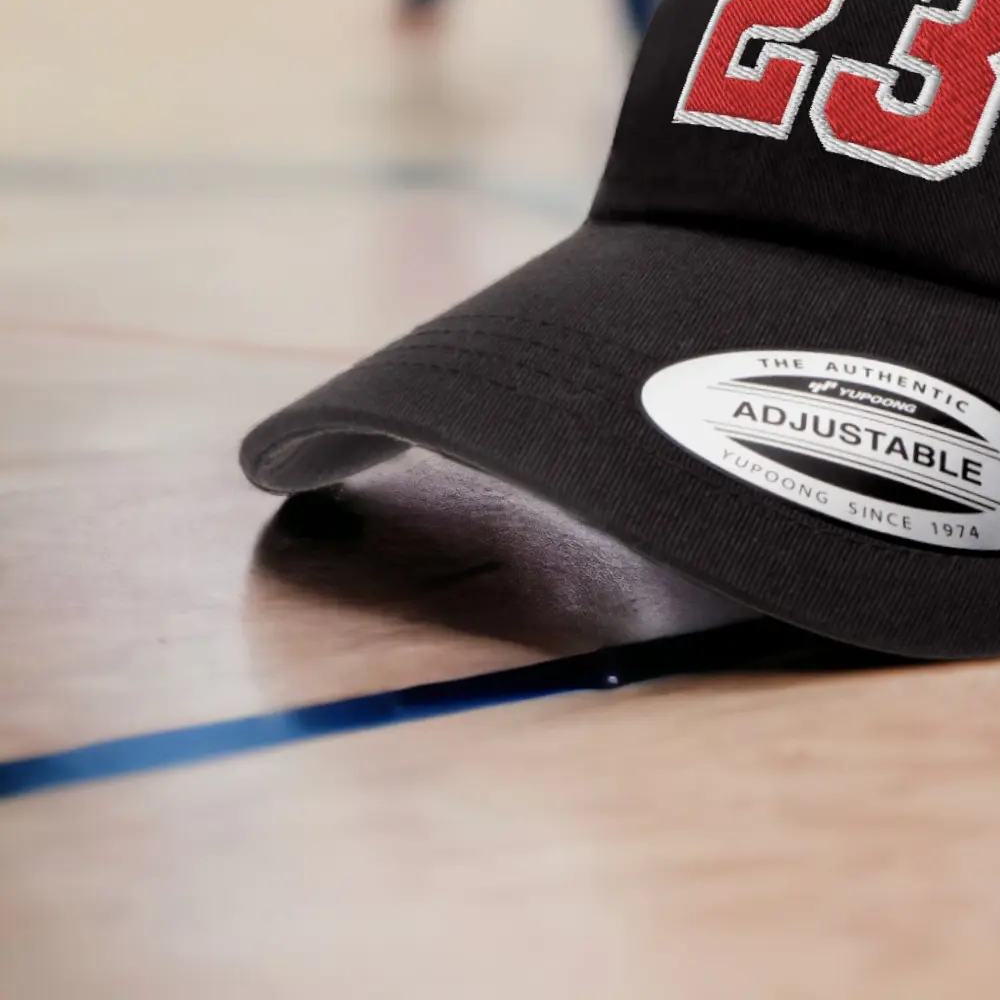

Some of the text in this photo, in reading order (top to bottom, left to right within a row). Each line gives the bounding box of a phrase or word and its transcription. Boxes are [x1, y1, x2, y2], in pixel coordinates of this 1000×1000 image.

[758, 358, 970, 413] THE AUTHENTIC
[839, 387, 918, 413] YUPOONG
[732, 401, 983, 486] ADJUSTABLE
[722, 448, 980, 539] YUPOONG SINCE 1974
